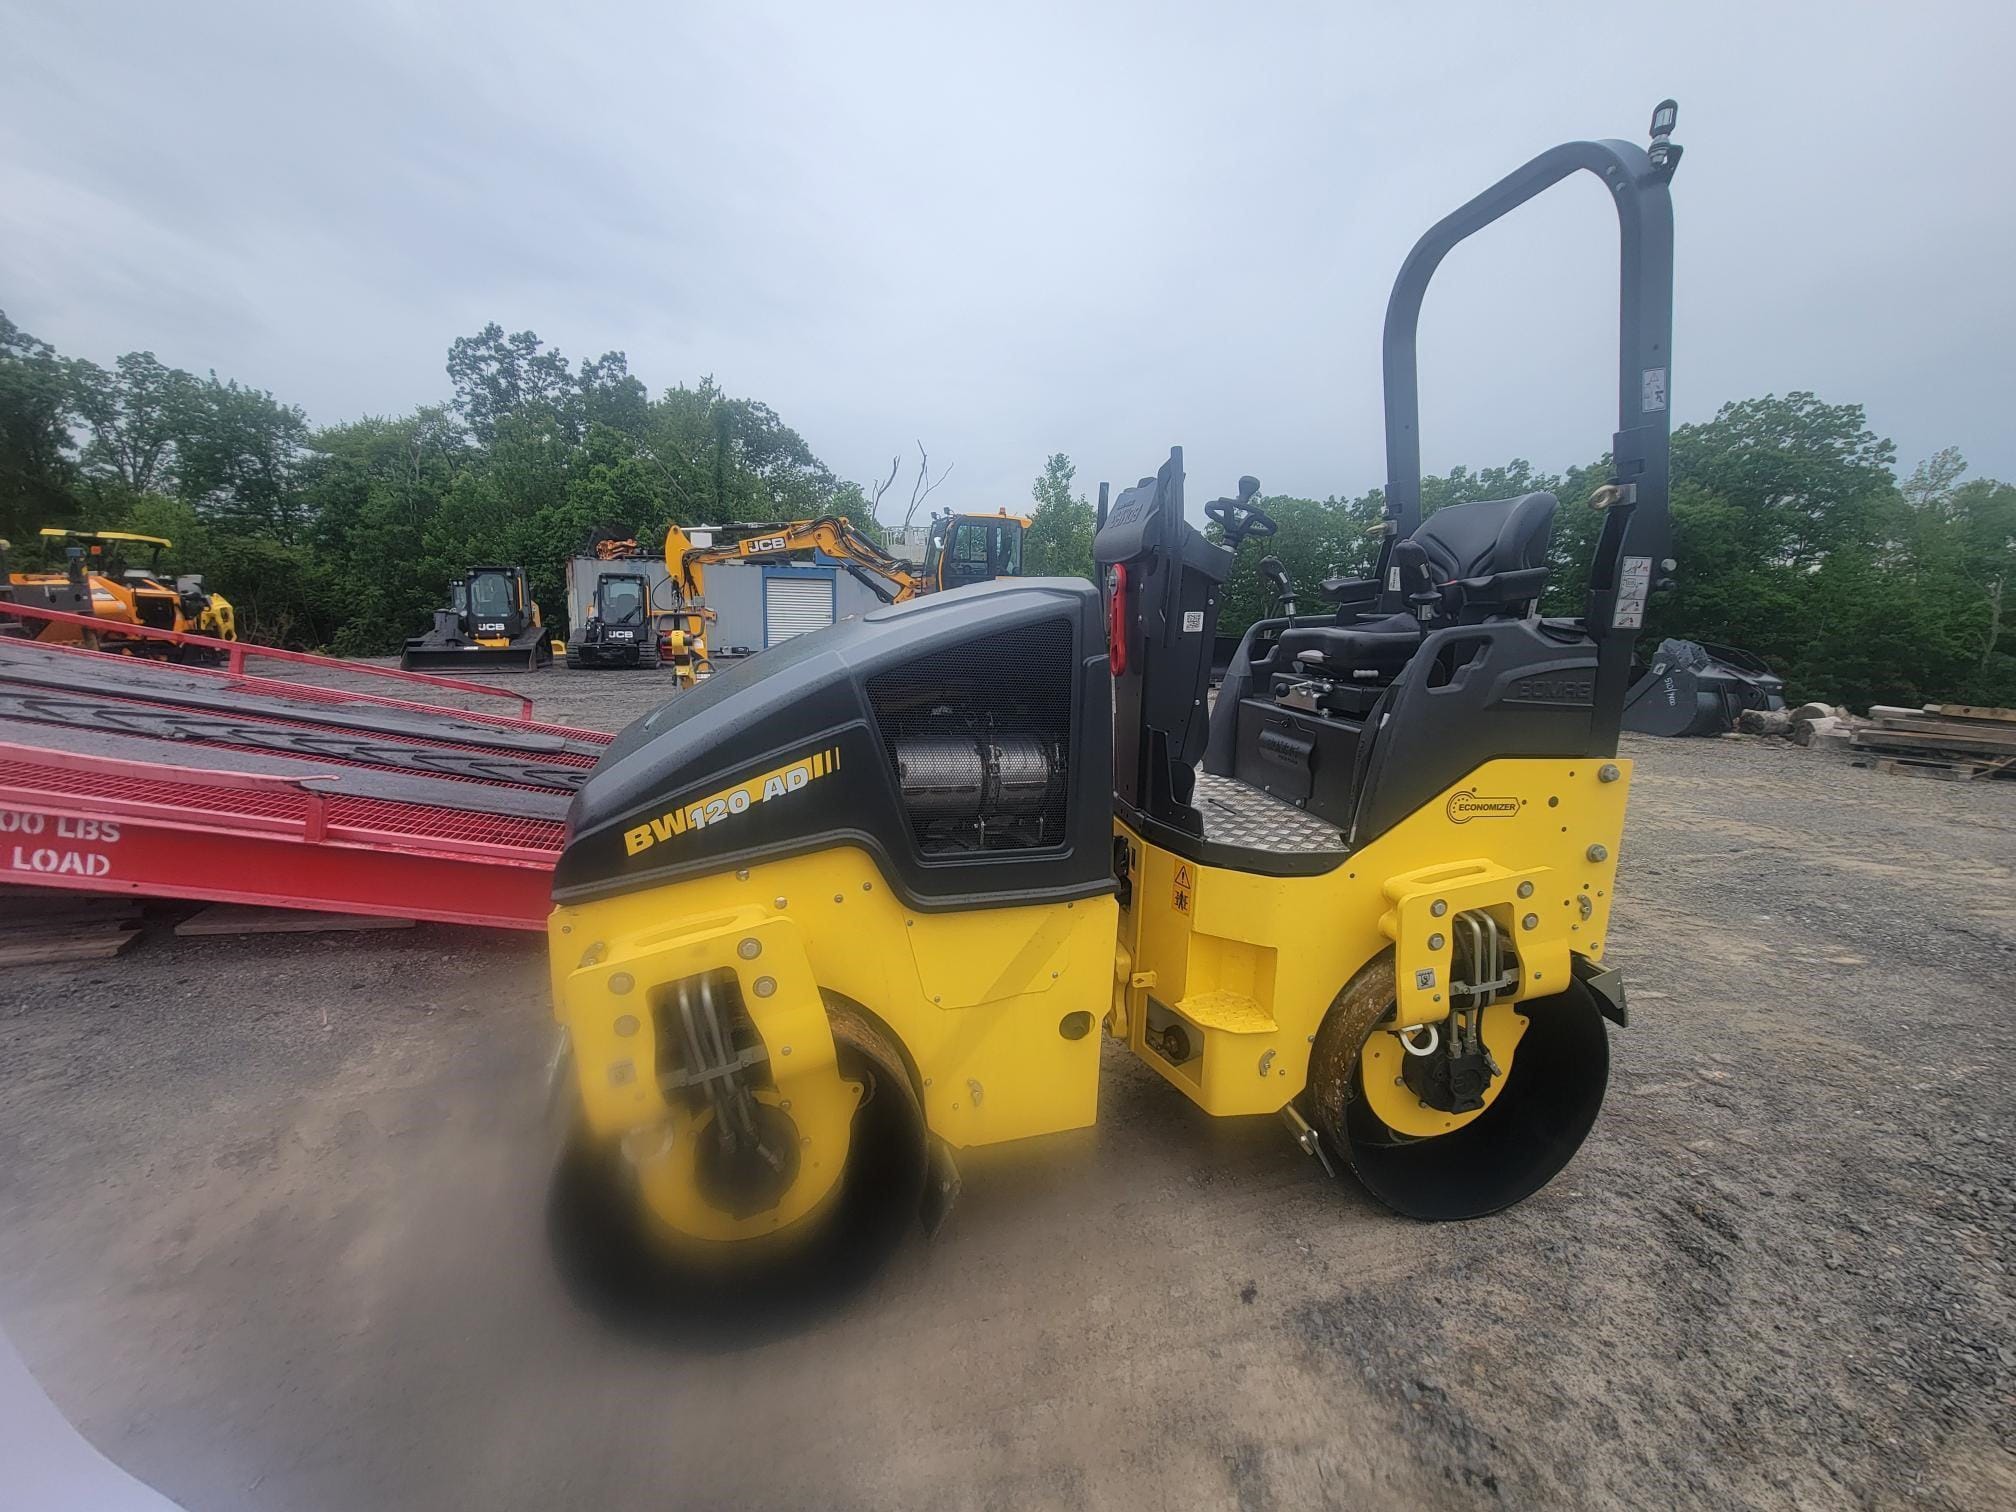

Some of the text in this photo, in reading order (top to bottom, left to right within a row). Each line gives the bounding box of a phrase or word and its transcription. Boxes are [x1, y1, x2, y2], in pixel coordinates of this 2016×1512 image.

[748, 537, 786, 552] JCB
[478, 623, 505, 631] JCB
[608, 630, 634, 638] JCB
[762, 766, 809, 803] AD
[1458, 803, 1516, 812] ECONOMIZER
[57, 815, 120, 842] LBS
[13, 846, 110, 876] LOAD
